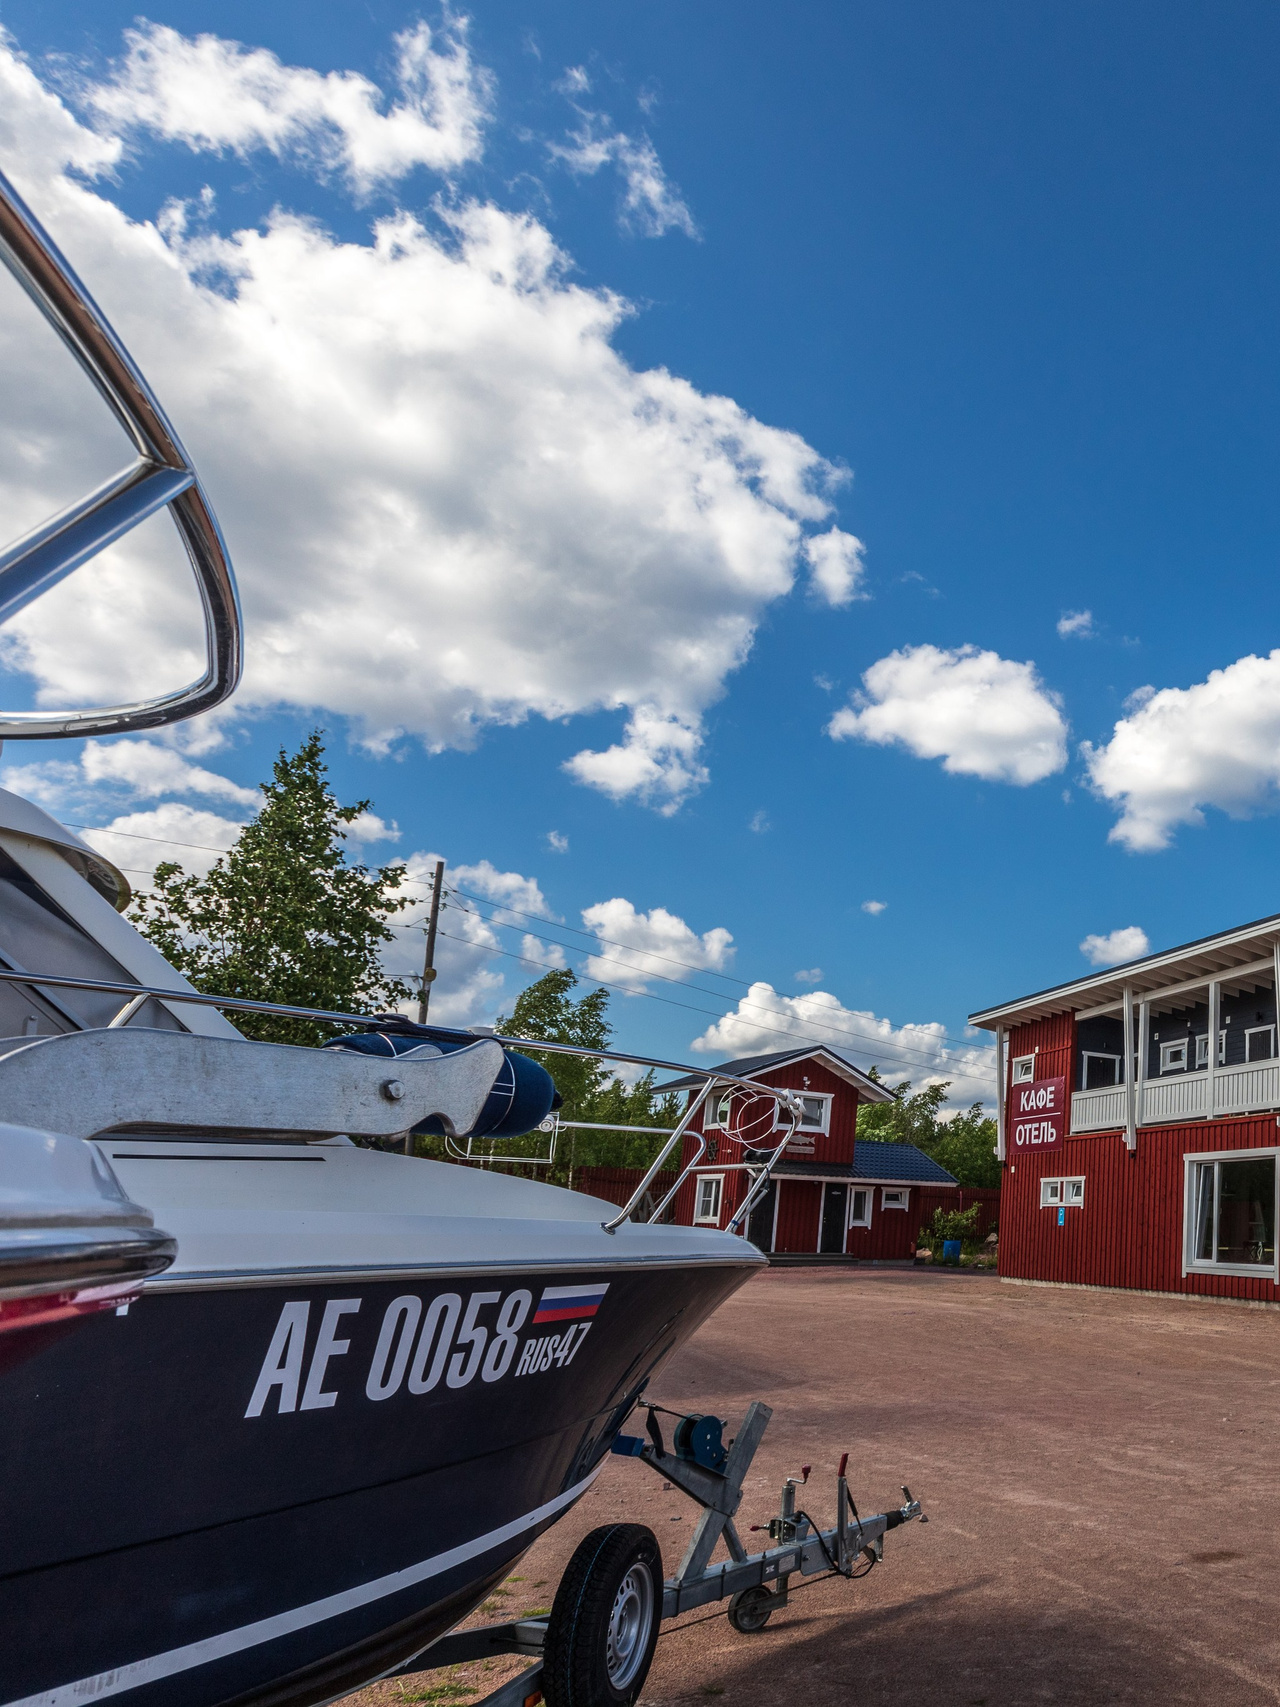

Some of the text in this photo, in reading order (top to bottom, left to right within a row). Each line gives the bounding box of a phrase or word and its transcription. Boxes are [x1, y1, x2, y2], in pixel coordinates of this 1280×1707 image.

[1020, 1086, 1055, 1112] КАФЕ
[1015, 1121, 1057, 1146] ОТЕЛЬ
[244, 1289, 593, 1418] AE 0058 RUS47
